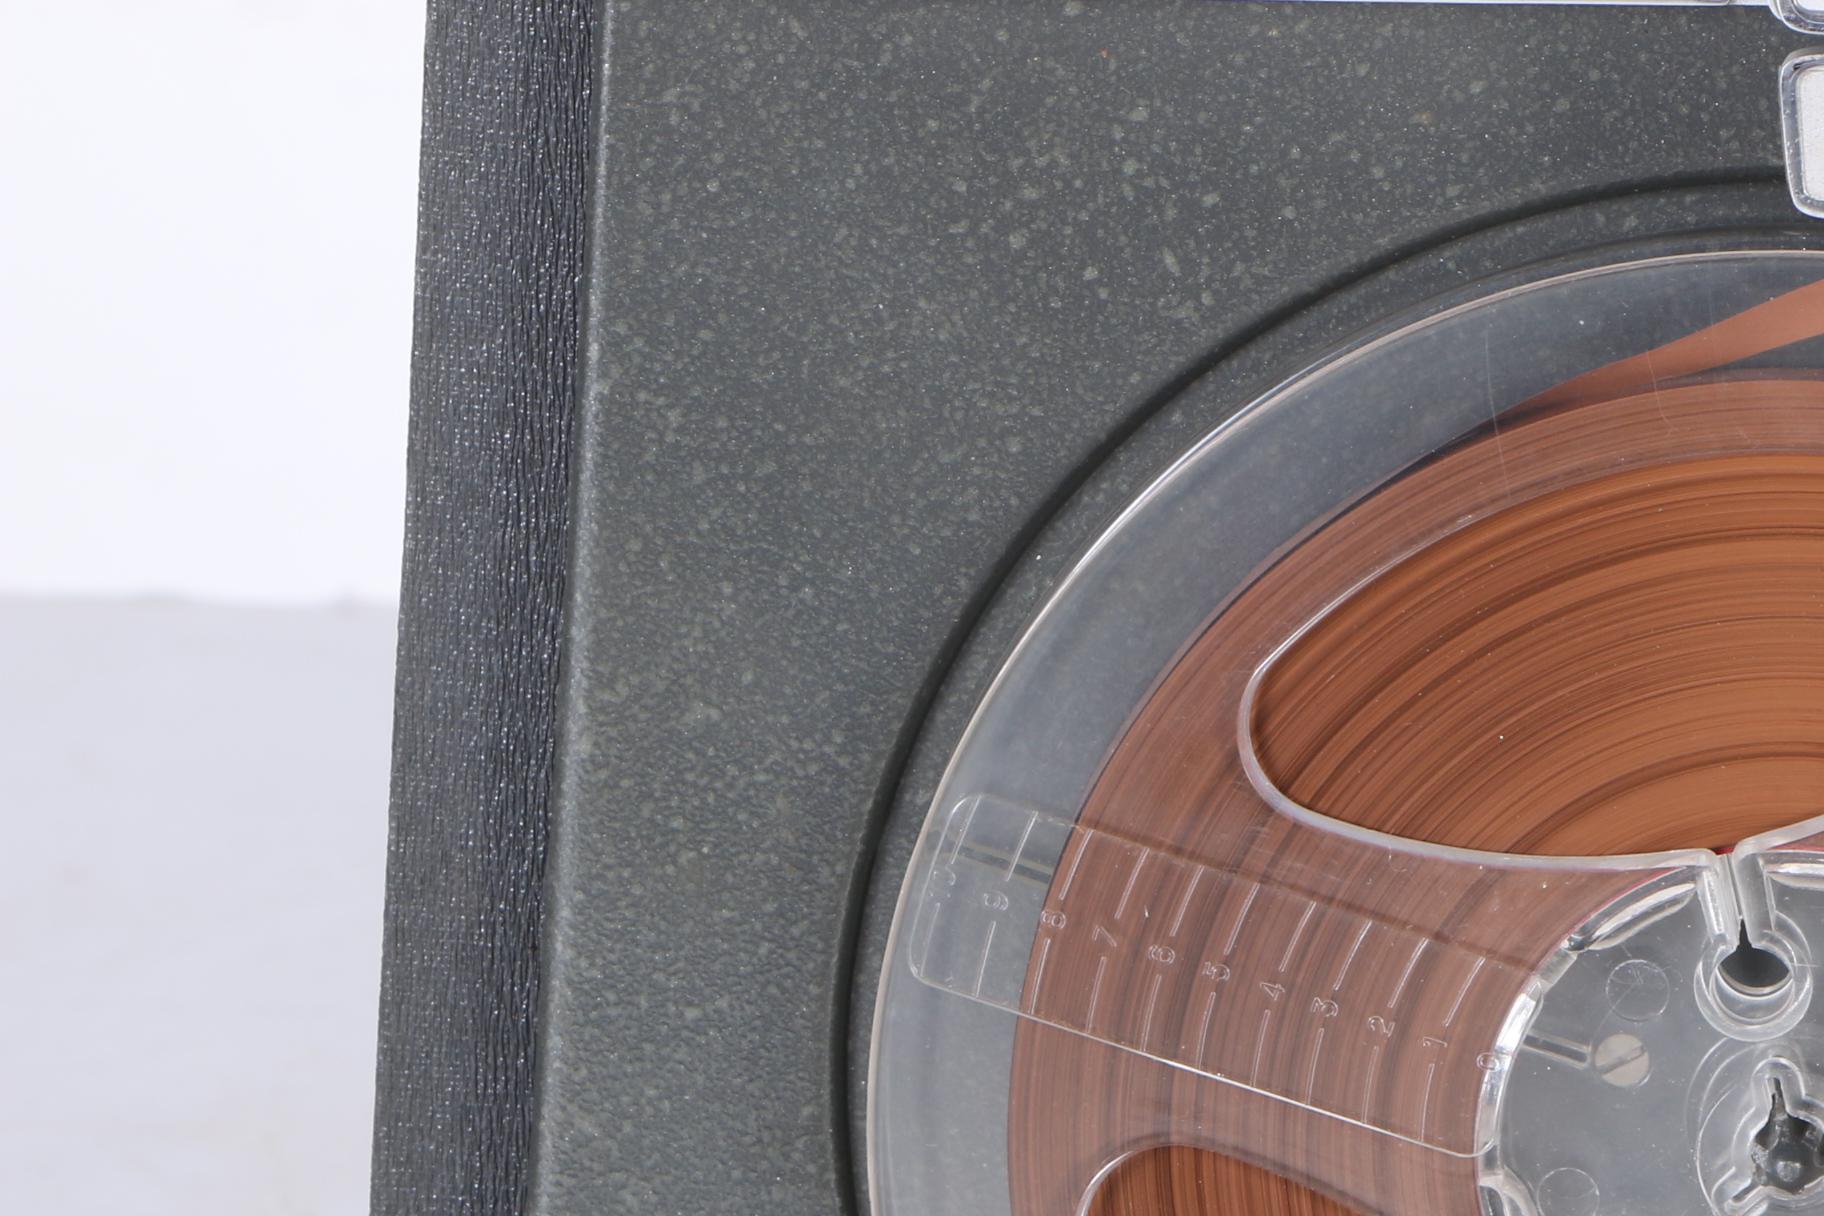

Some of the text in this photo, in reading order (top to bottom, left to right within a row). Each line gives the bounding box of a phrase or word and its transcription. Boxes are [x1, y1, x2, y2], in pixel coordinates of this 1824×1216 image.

[1260, 979, 1287, 1001] 4
[1312, 997, 1339, 1019] 3
[1367, 1015, 1395, 1038] 2
